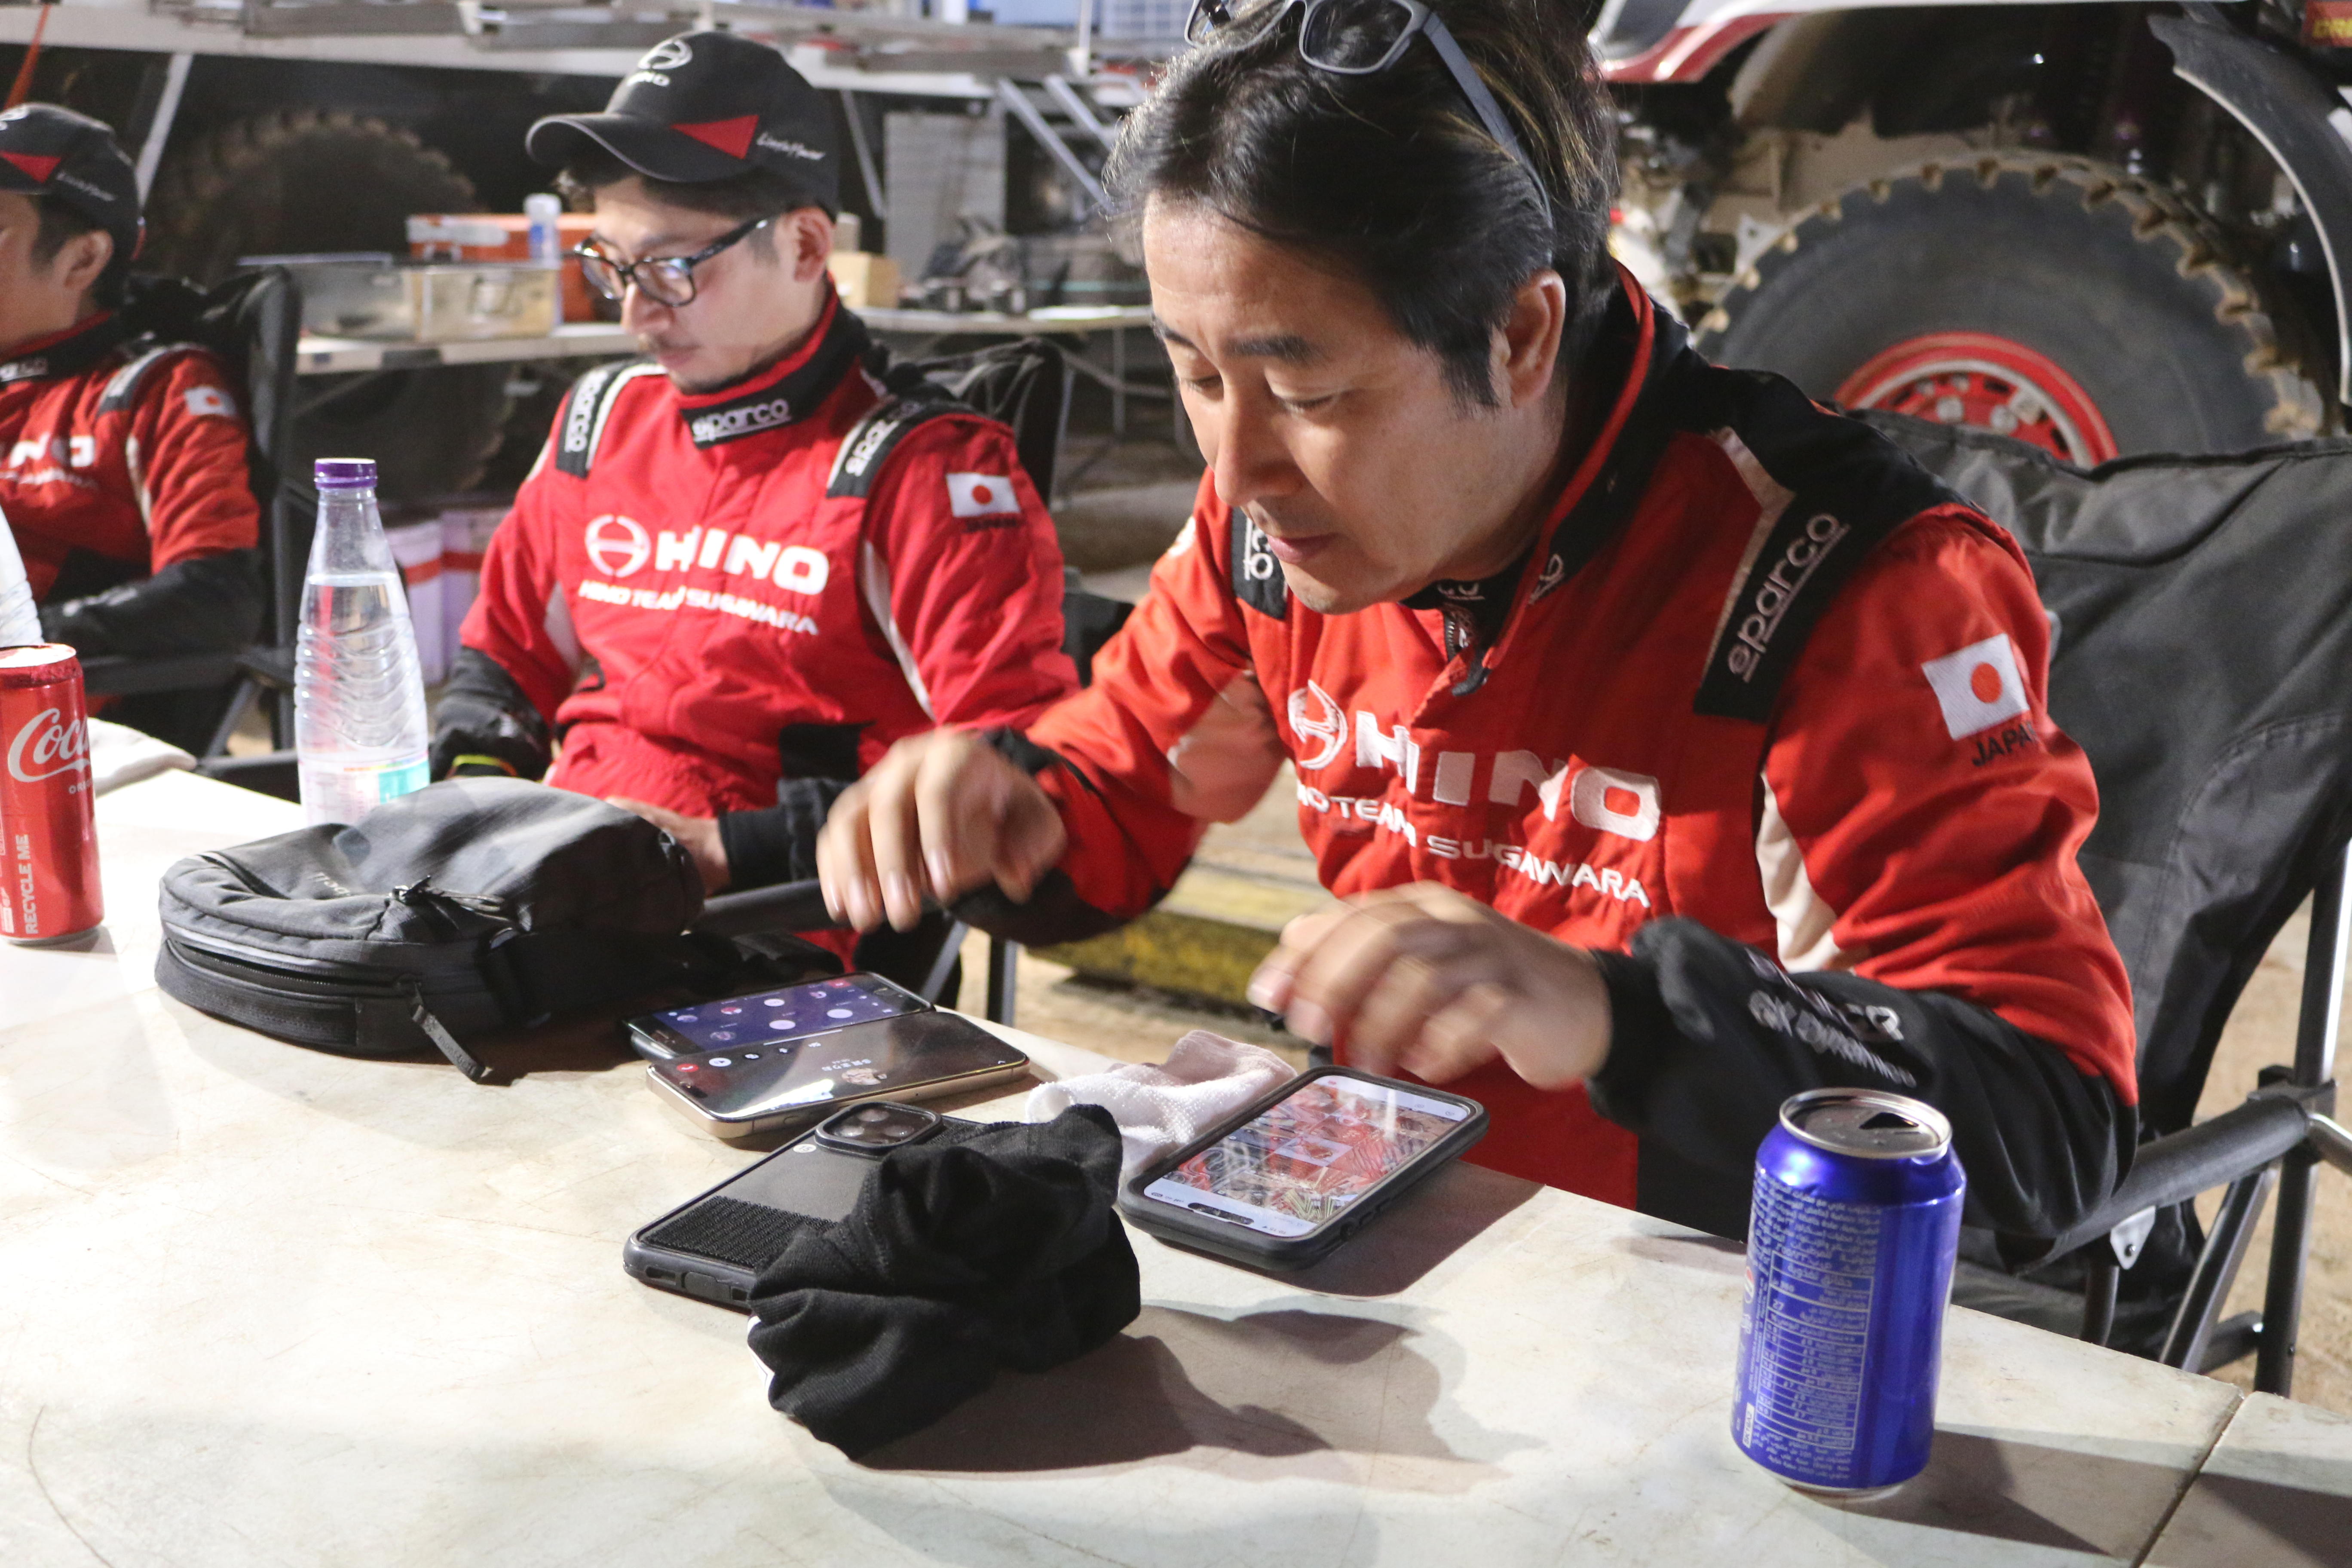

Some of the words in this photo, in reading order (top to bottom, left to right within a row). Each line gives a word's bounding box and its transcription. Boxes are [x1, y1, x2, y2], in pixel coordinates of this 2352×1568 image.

[692, 398, 792, 443] sparco
[655, 525, 830, 595] HINO
[1727, 513, 1851, 683] sparco
[1356, 710, 1662, 842] HINO
[15, 834, 31, 860] ME
[1427, 834, 1651, 908] SUGAWARA
[18, 863, 39, 934] RECYCLE
